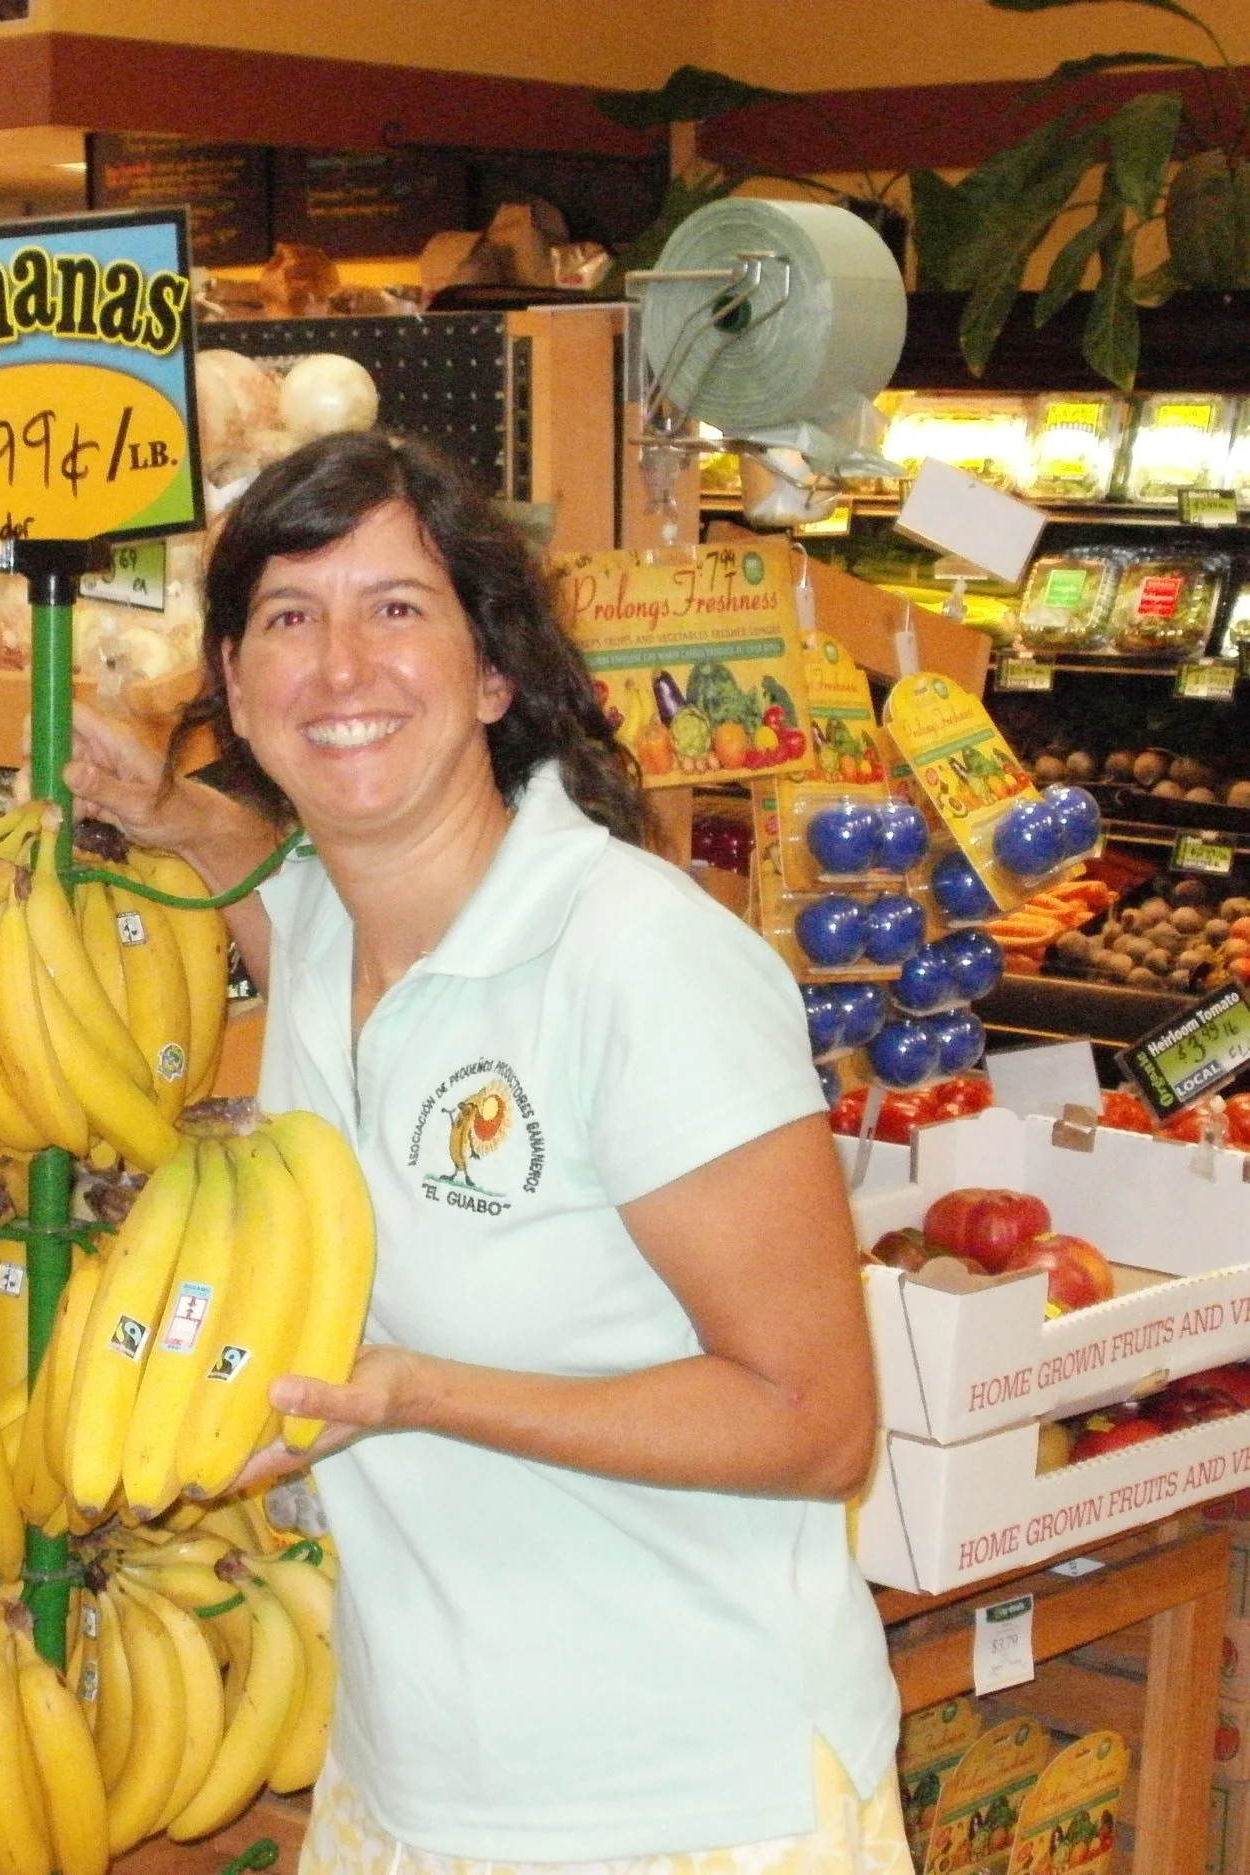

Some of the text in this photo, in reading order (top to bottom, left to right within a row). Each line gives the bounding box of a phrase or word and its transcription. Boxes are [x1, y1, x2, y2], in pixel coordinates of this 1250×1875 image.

[564, 570, 778, 631] Prolongs Freshness
[1147, 1019, 1200, 1058] Heirloom
[1196, 992, 1239, 1023] Tomato
[1175, 1064, 1220, 1097] LOCAL
[435, 1082, 449, 1099] DE
[522, 1121, 546, 1194] BANANEROS
[969, 1367, 1032, 1412] HOME
[1037, 1340, 1106, 1390] GROWN
[1111, 1316, 1174, 1362] FRUITS
[1179, 1304, 1223, 1339] AND
[958, 1524, 1020, 1571] HOME
[1026, 1496, 1102, 1547] GROWN
[1107, 1471, 1178, 1517] FRUITS
[1183, 1456, 1226, 1492] AND
